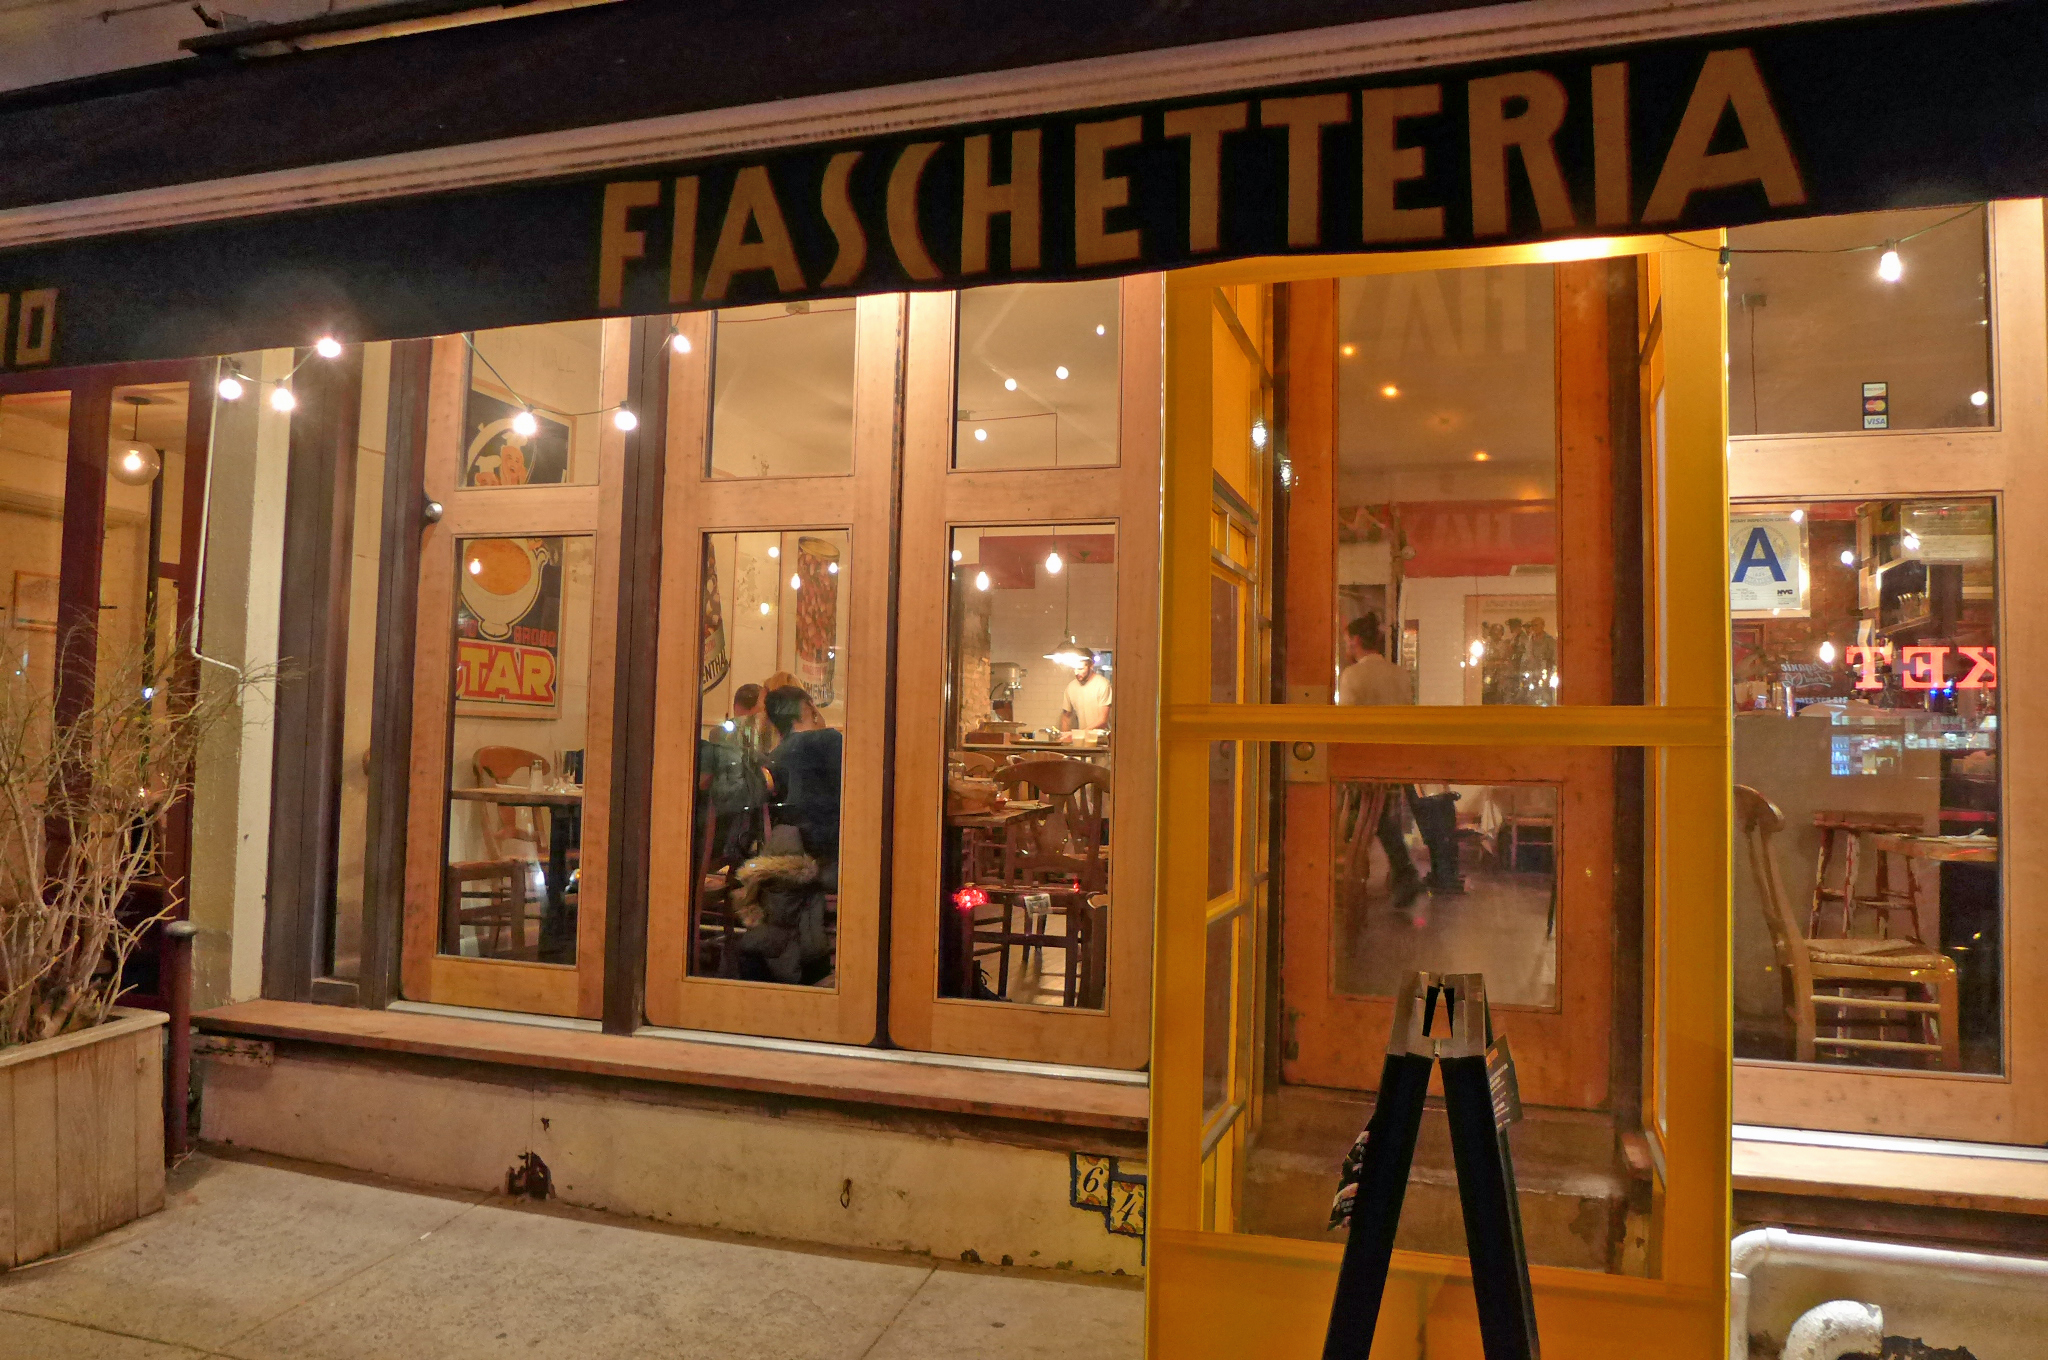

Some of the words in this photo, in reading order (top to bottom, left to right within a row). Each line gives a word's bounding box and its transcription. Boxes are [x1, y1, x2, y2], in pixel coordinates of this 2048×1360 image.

[598, 46, 1806, 310] FIASCHETTERIA
[1731, 527, 1787, 582] A
[457, 645, 550, 698] TAR
